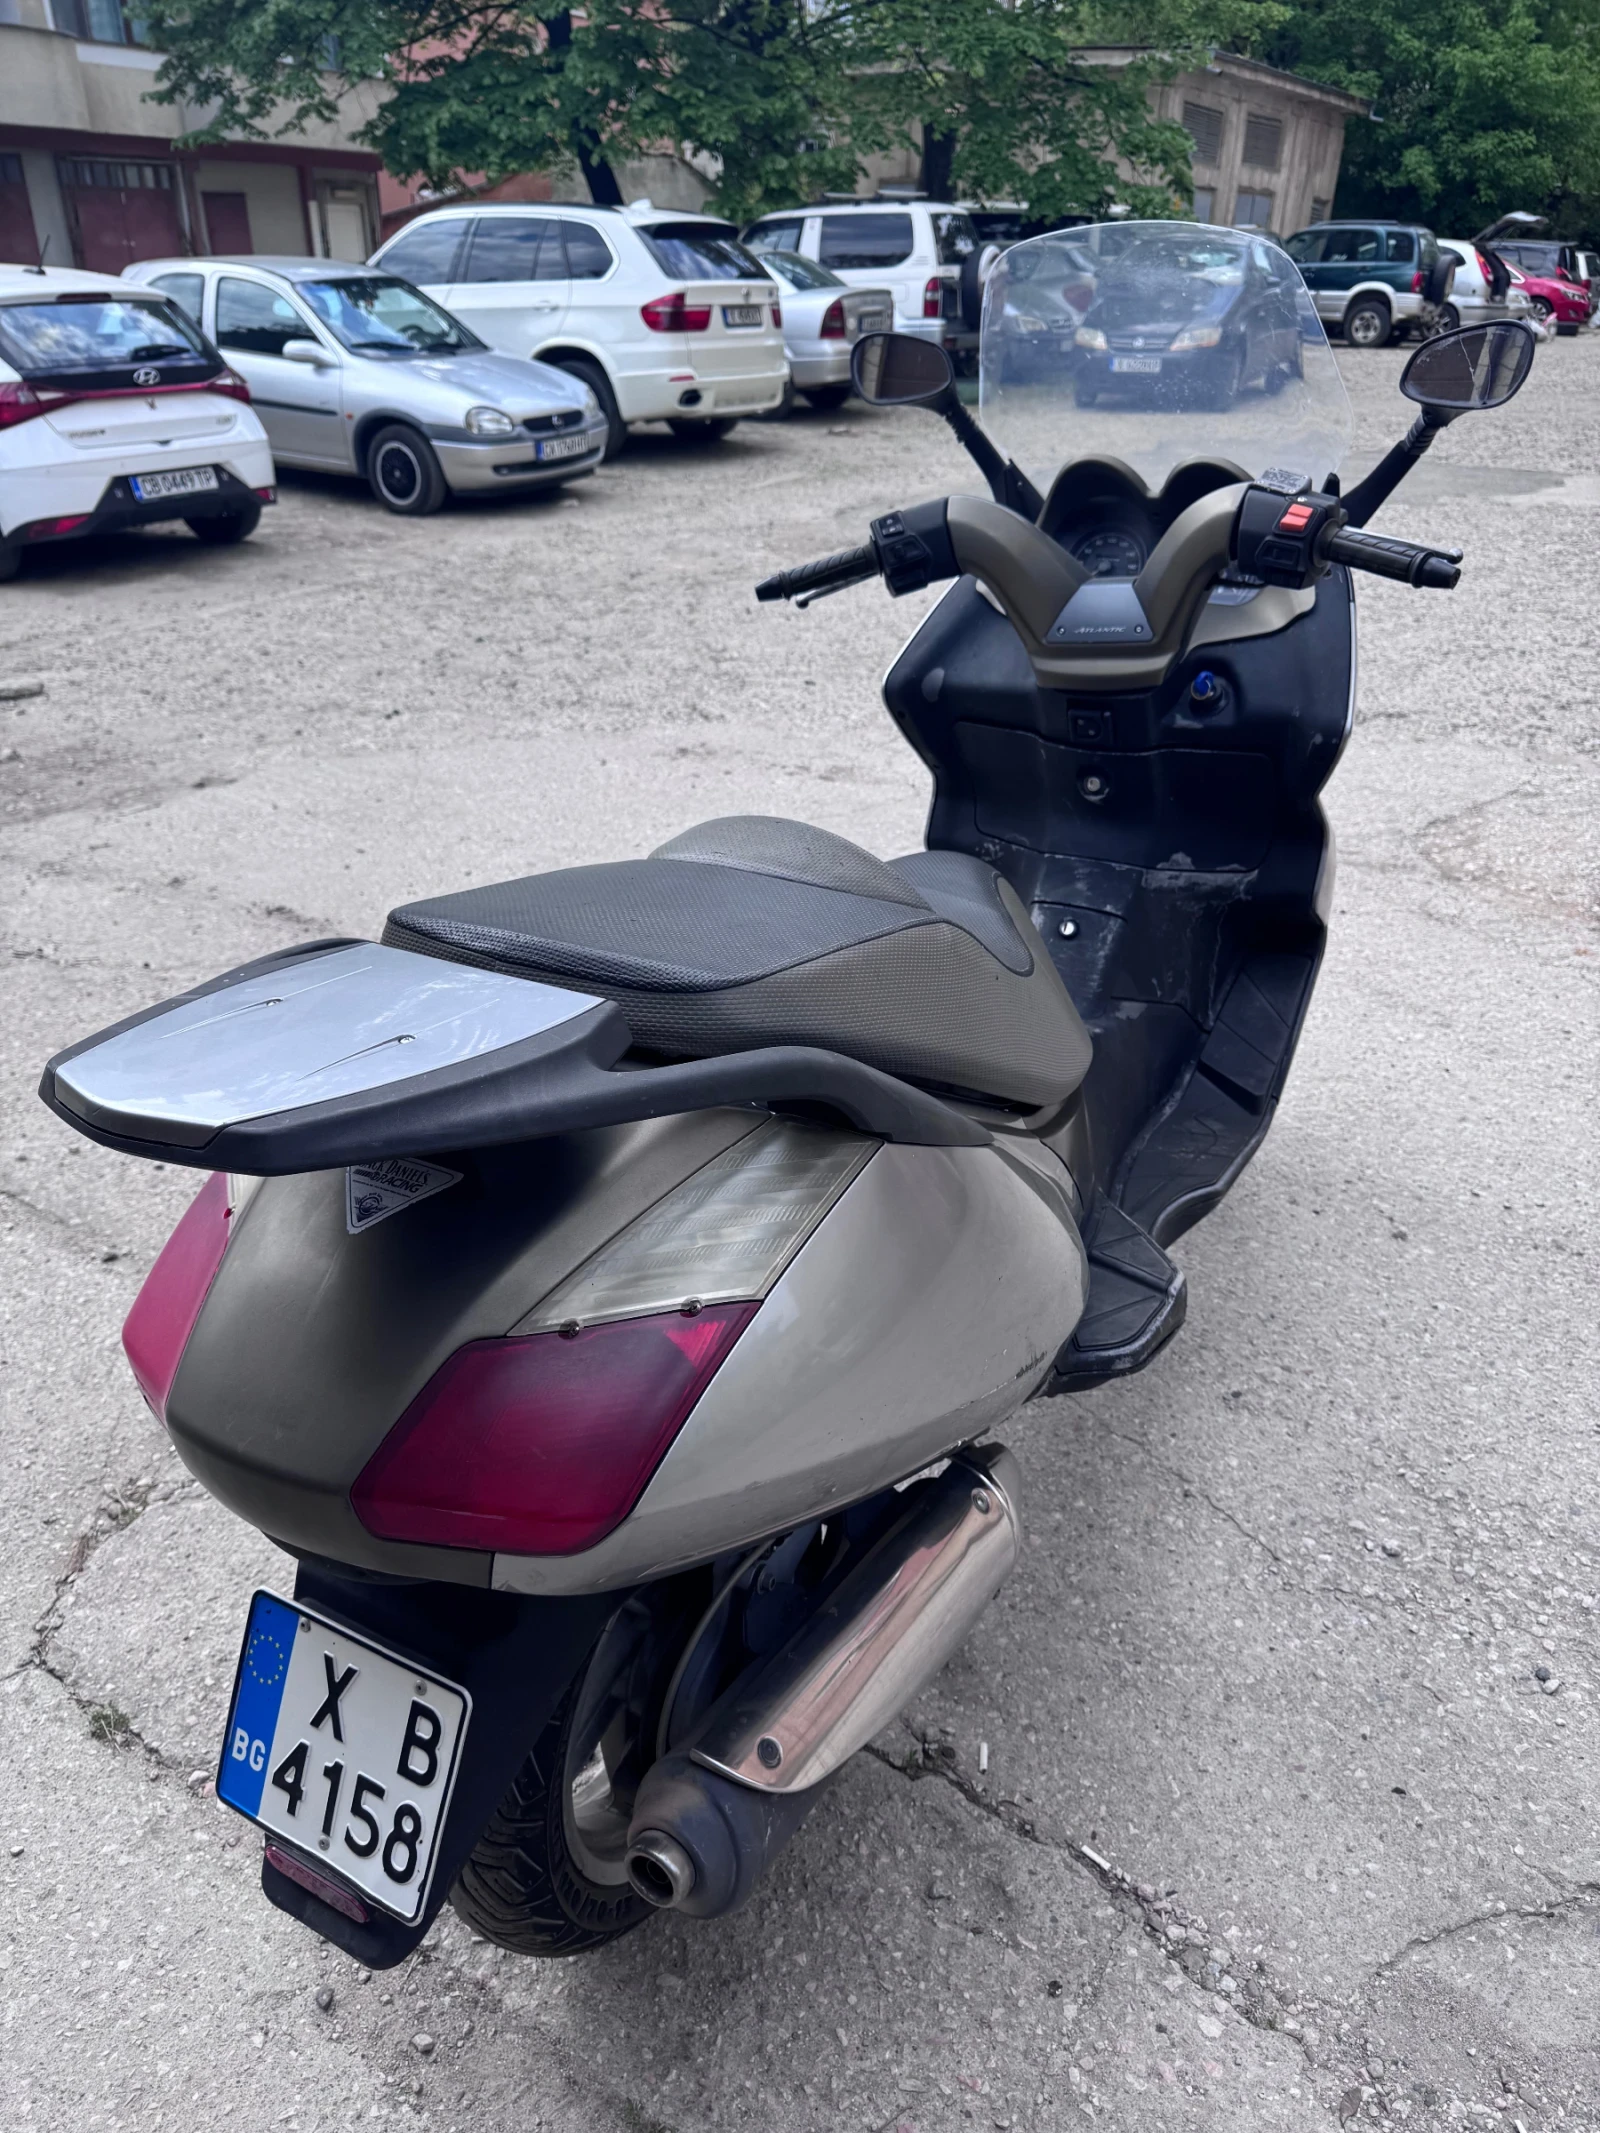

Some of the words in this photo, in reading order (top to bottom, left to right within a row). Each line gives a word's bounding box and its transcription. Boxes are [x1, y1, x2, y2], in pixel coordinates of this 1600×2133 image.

[1074, 625, 1127, 634] ATLANTIC
[379, 1173, 424, 1193] RACING
[310, 1651, 360, 1743] X
[396, 1697, 442, 1788] B
[231, 1727, 266, 1772] BG
[271, 1738, 423, 1884] 4158
